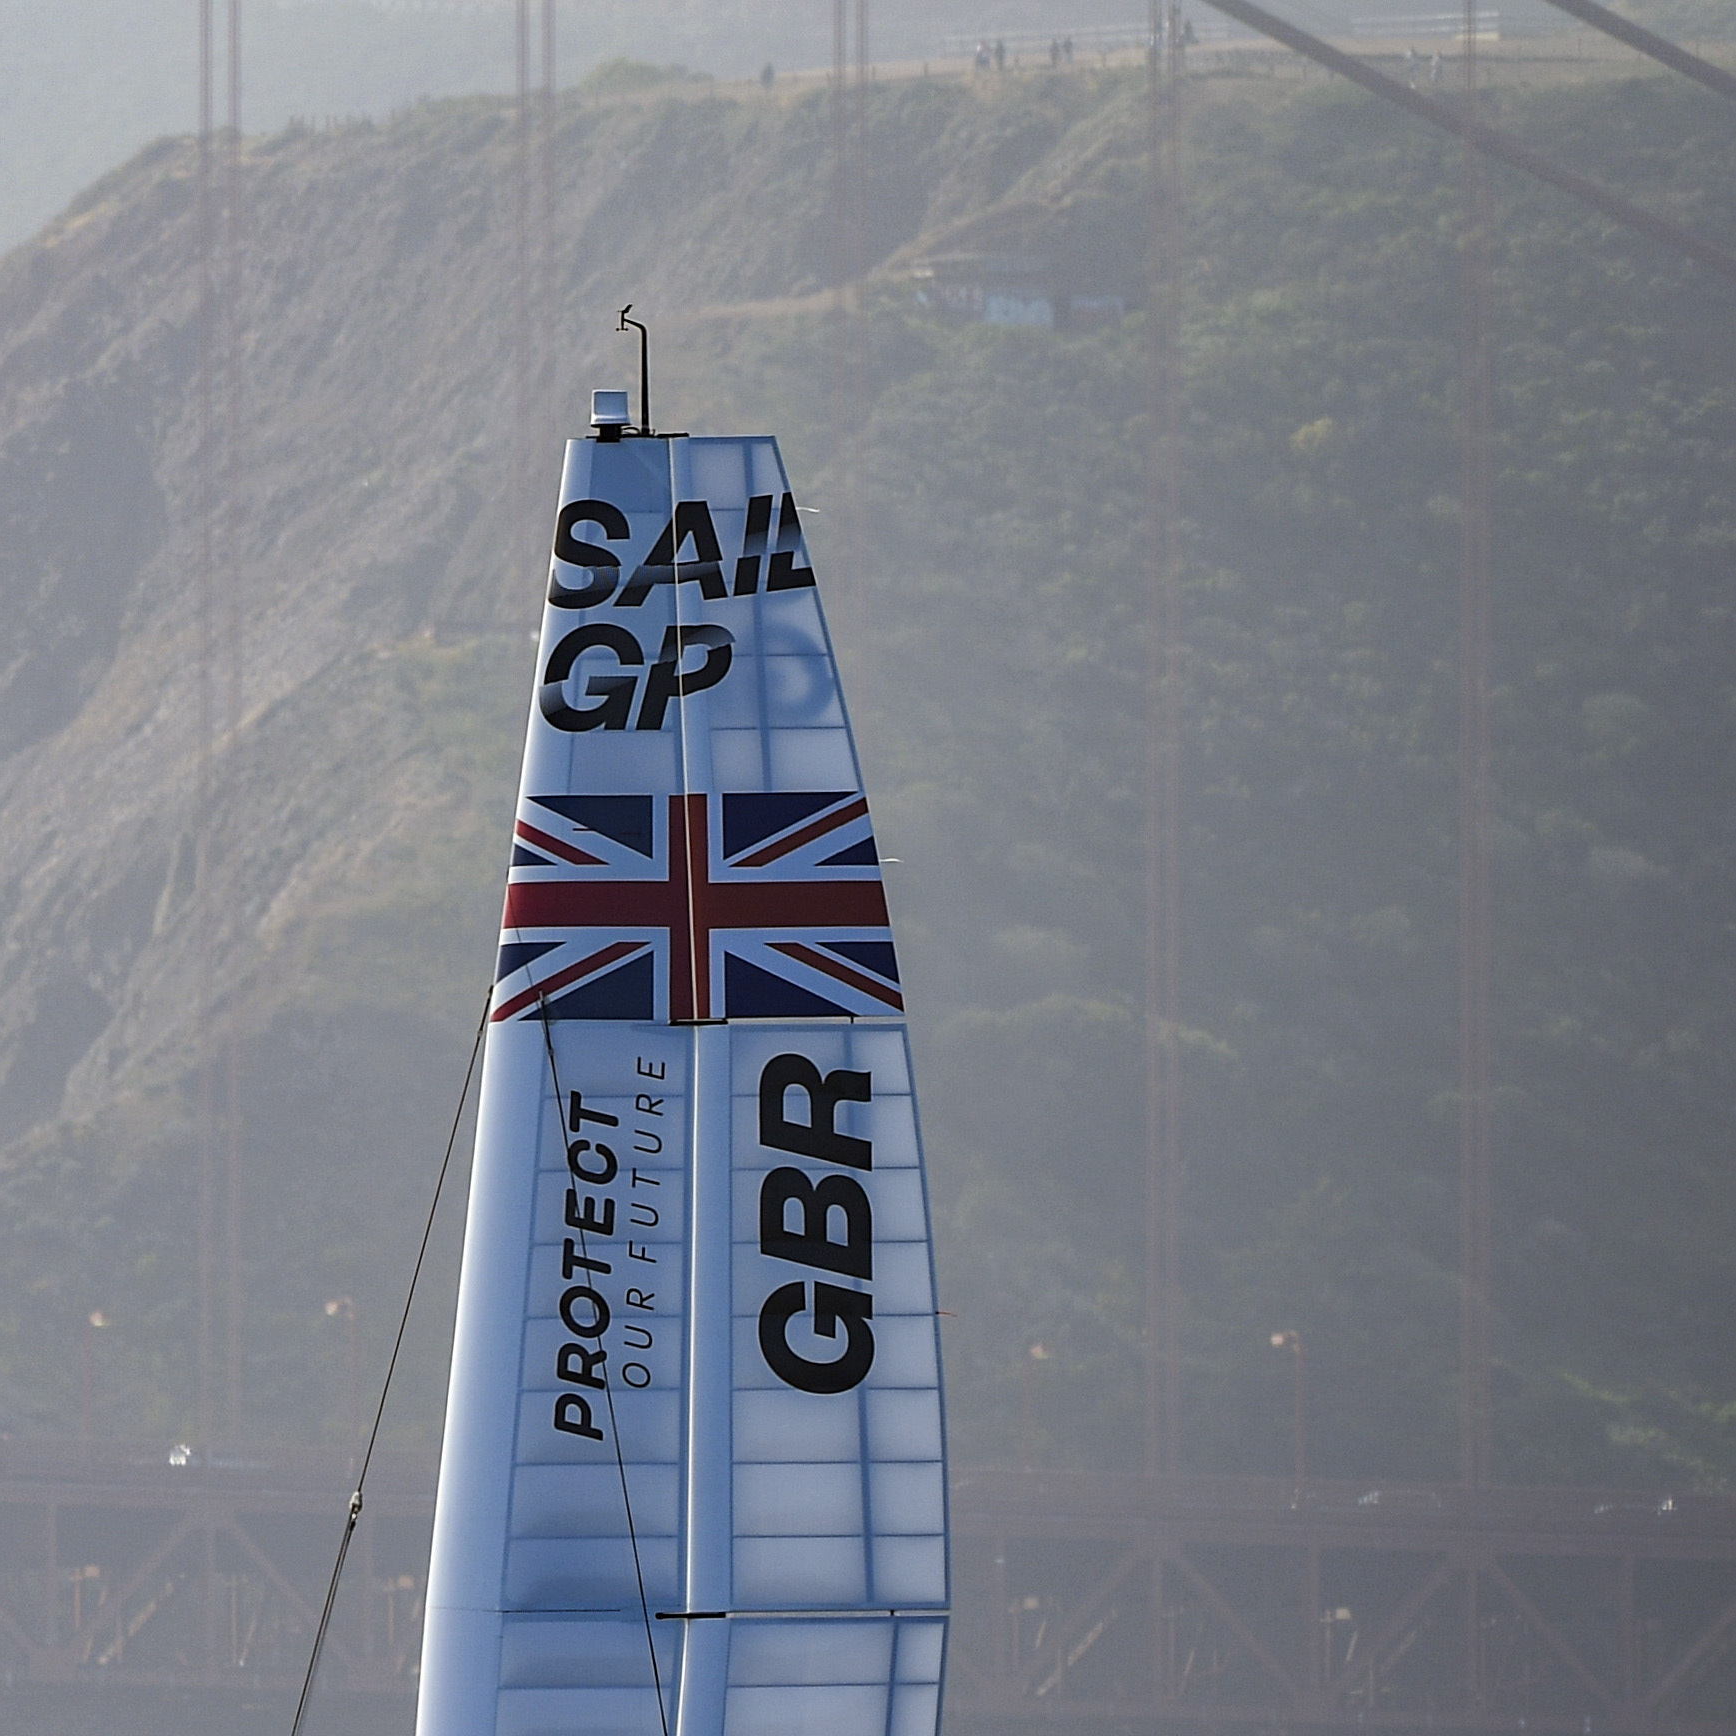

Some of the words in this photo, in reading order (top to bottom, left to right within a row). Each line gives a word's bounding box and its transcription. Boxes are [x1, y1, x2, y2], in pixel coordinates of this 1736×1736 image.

[547, 491, 817, 610] SAIL
[539, 622, 736, 733] GP
[628, 1054, 666, 1264] FUTURE
[757, 1052, 876, 1396] GBR
[553, 1090, 620, 1441] PROTECT
[621, 1286, 656, 1390] OUR
